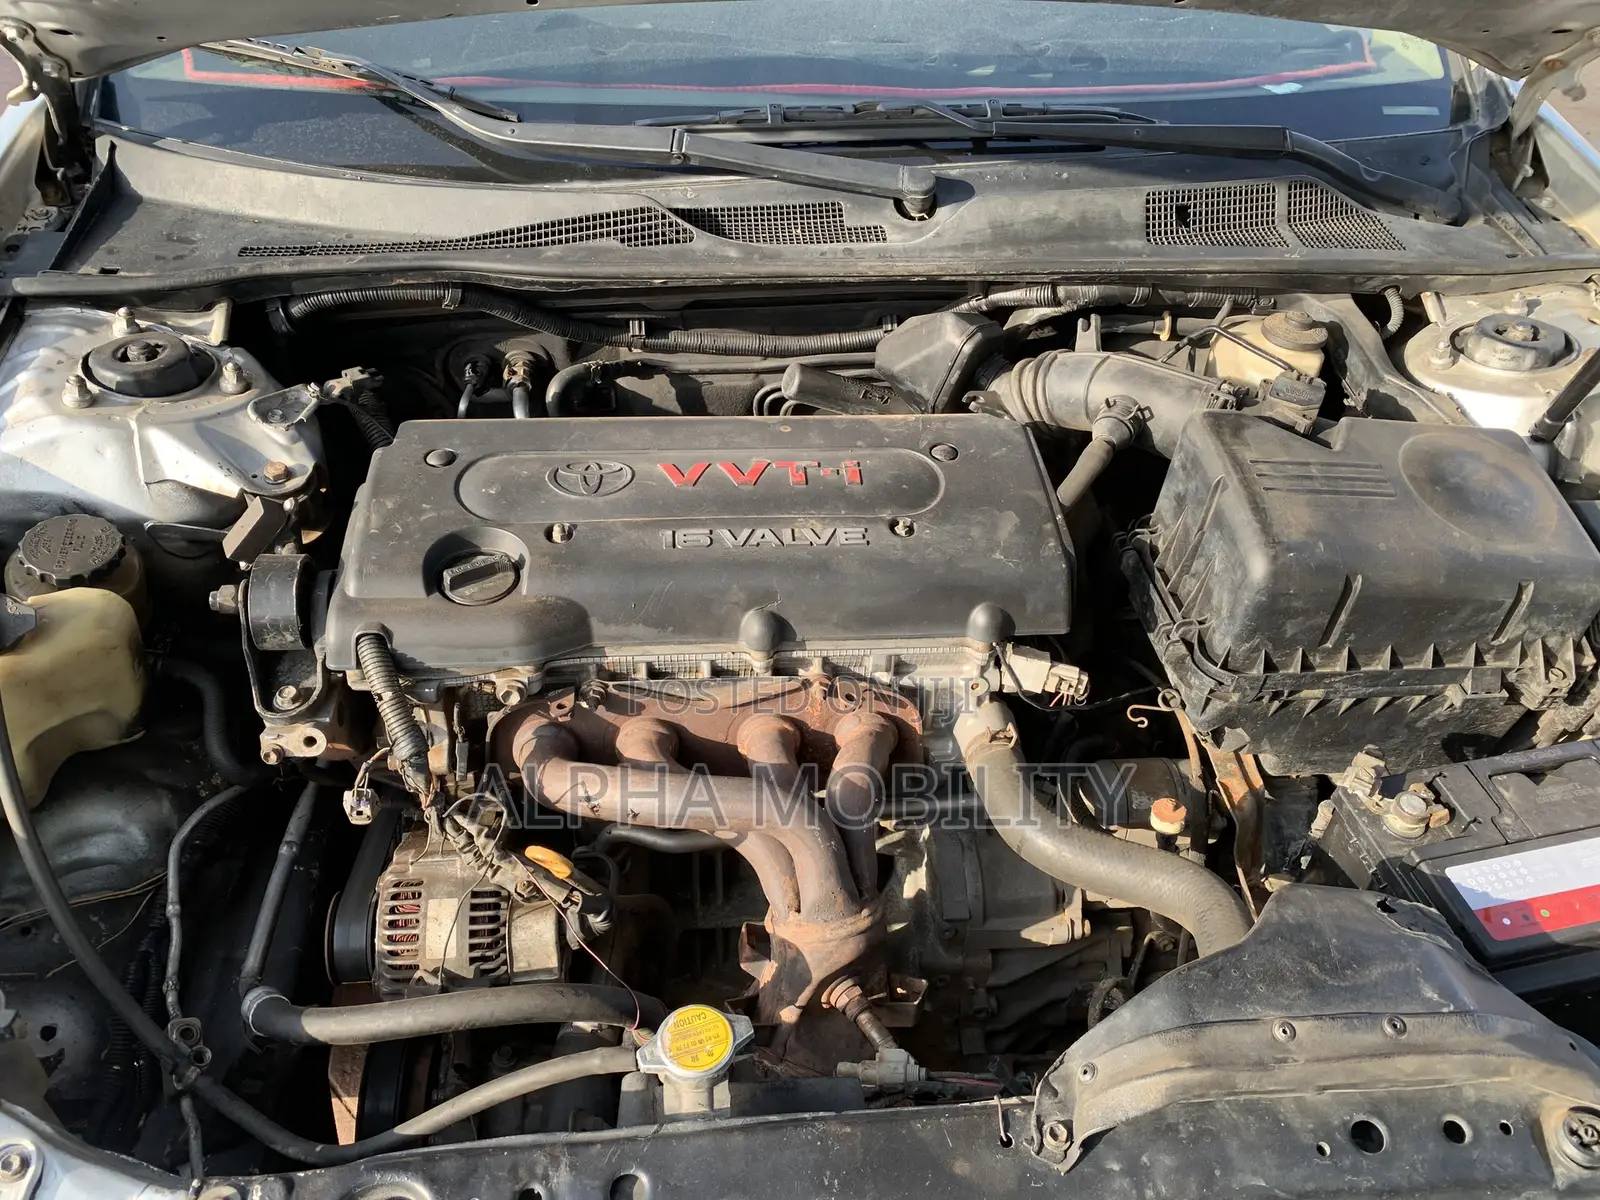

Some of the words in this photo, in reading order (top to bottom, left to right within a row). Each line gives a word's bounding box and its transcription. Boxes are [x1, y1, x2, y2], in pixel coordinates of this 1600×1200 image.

[656, 461, 864, 488] VVT-i
[659, 528, 713, 550] 16
[717, 527, 871, 549] VALVE
[673, 1012, 706, 1029] CAUTION
